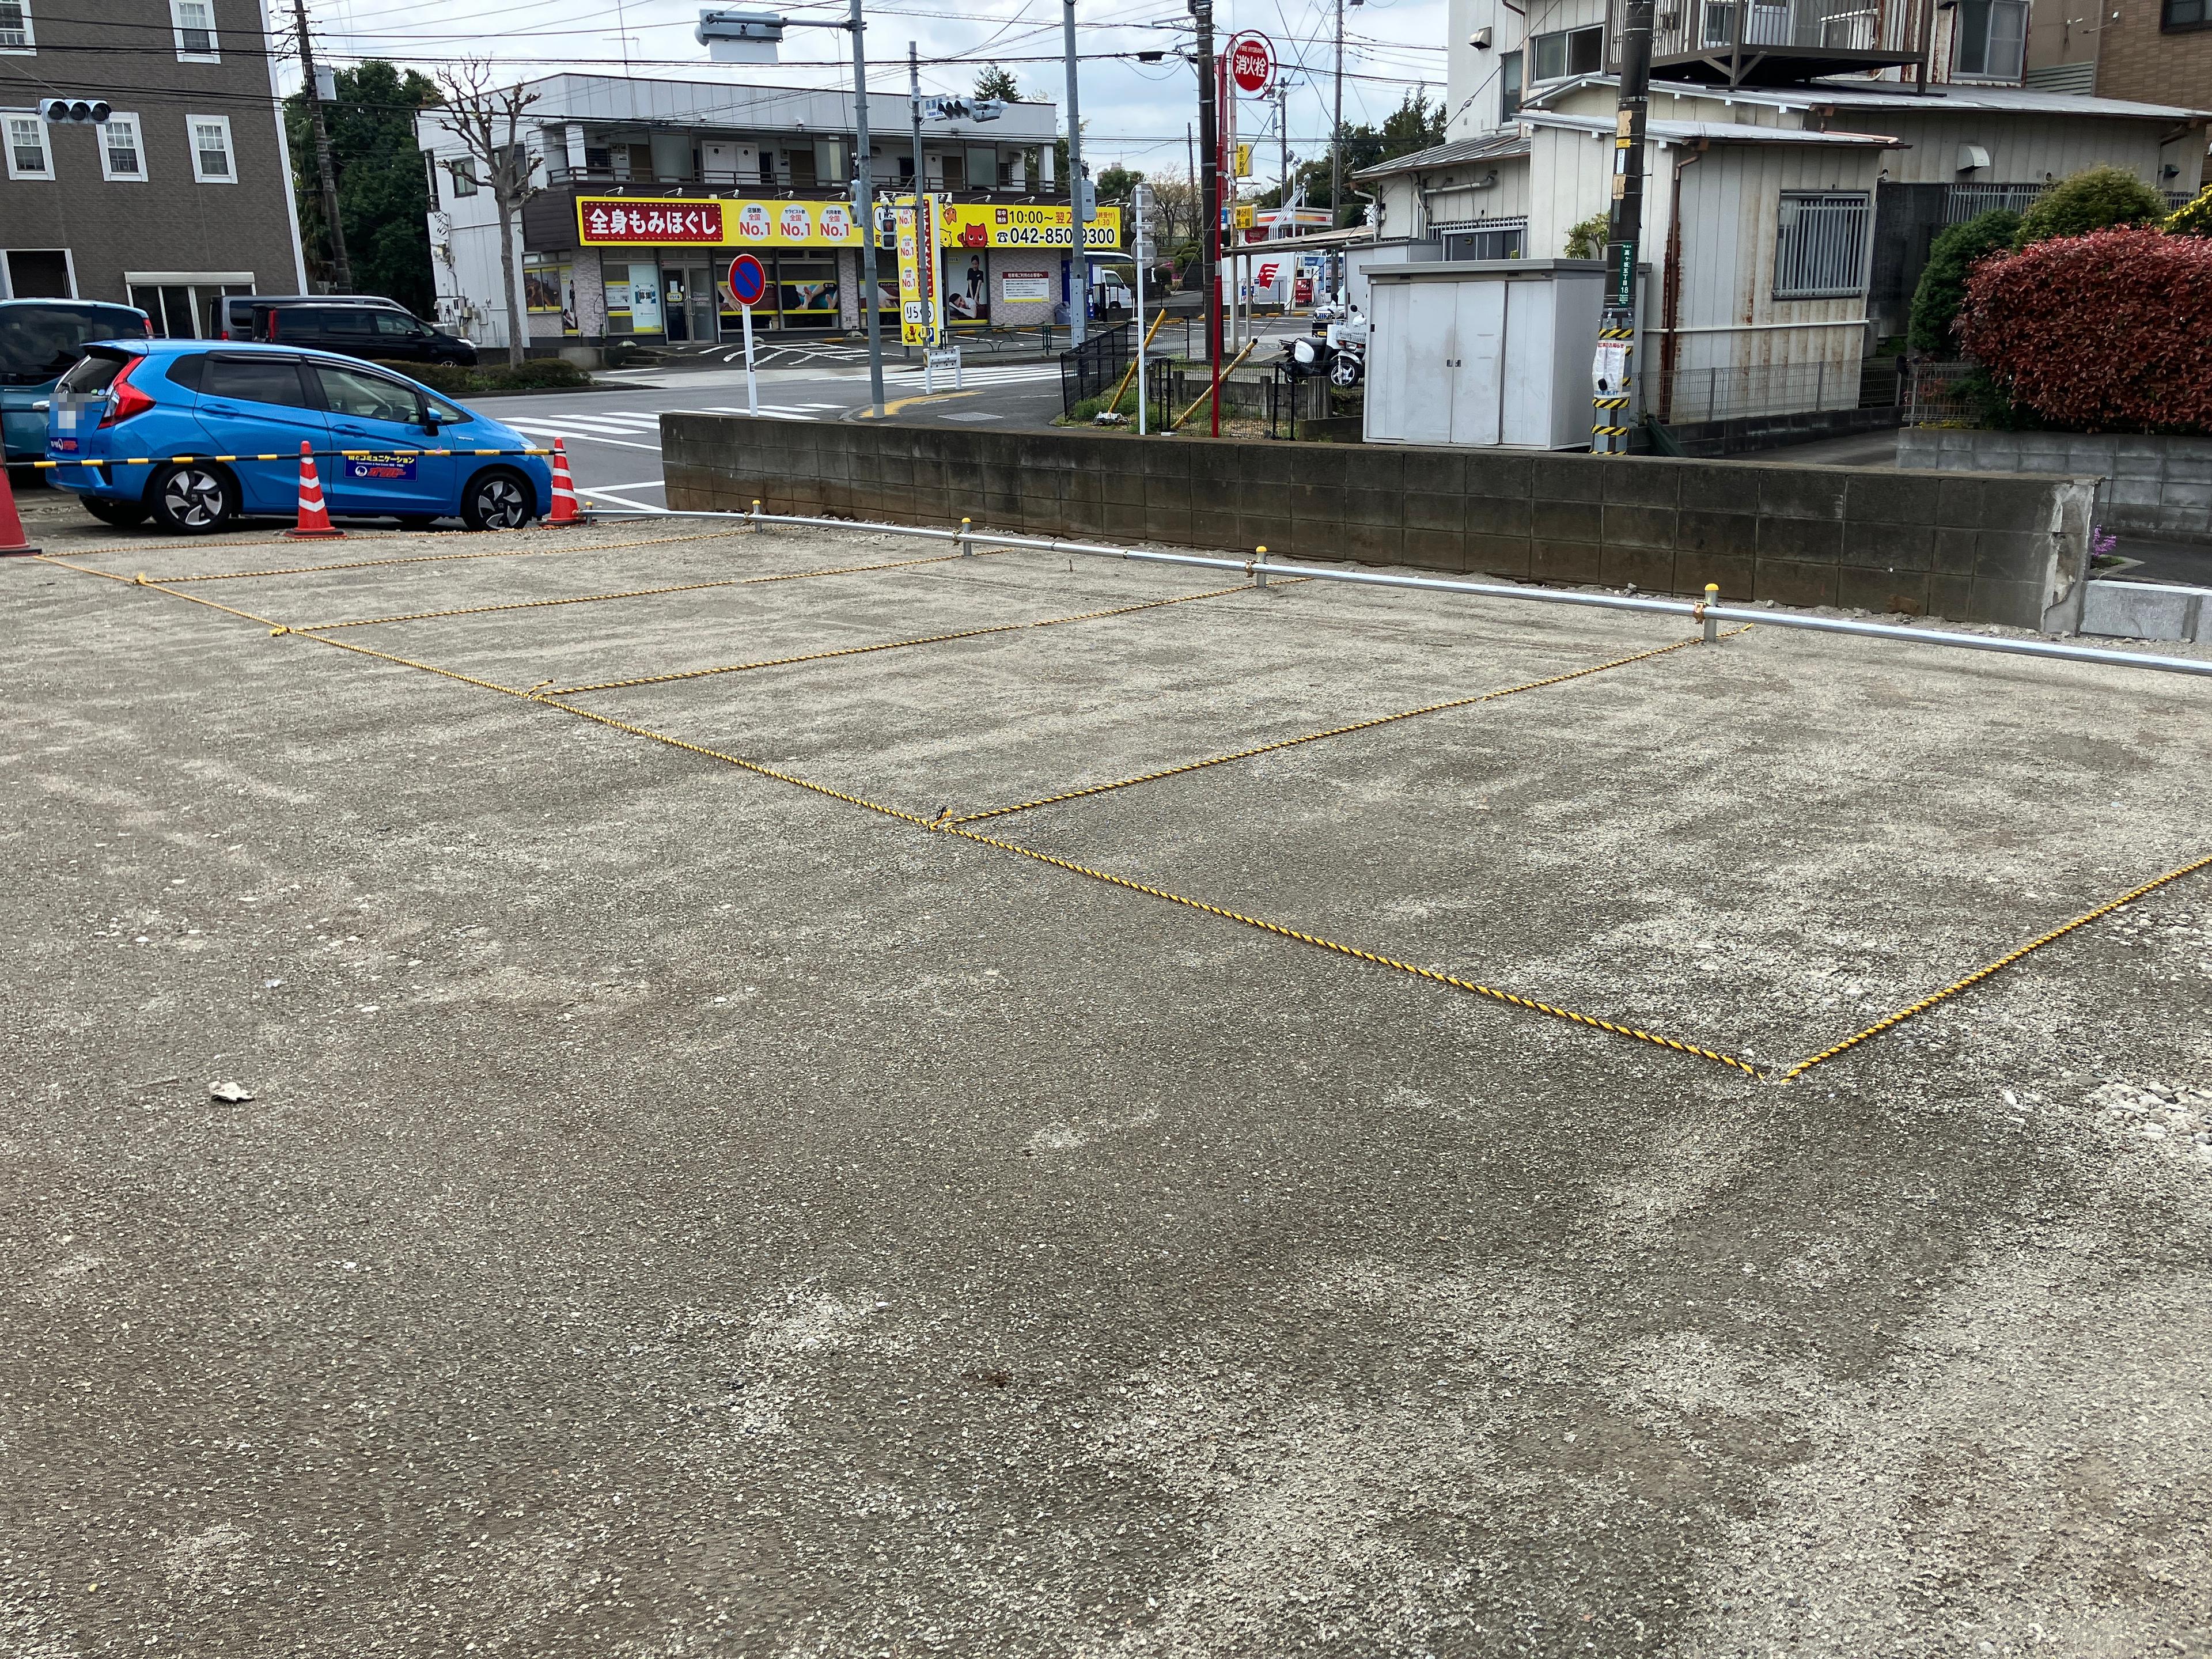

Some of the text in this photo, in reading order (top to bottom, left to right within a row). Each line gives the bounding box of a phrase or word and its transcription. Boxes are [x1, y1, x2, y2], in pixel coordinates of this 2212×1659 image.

[1236, 54, 1267, 77] 消火栓
[899, 215, 912, 224] No.1
[1236, 208, 1250, 218] 神奈川
[589, 208, 716, 234] 全身もみほぐし
[740, 222, 770, 235] No.1
[781, 222, 810, 236] No.1
[820, 223, 849, 236] No.1
[1010, 228, 1115, 244] 042-8509300
[901, 247, 914, 256] No.1
[902, 279, 915, 287] No.1
